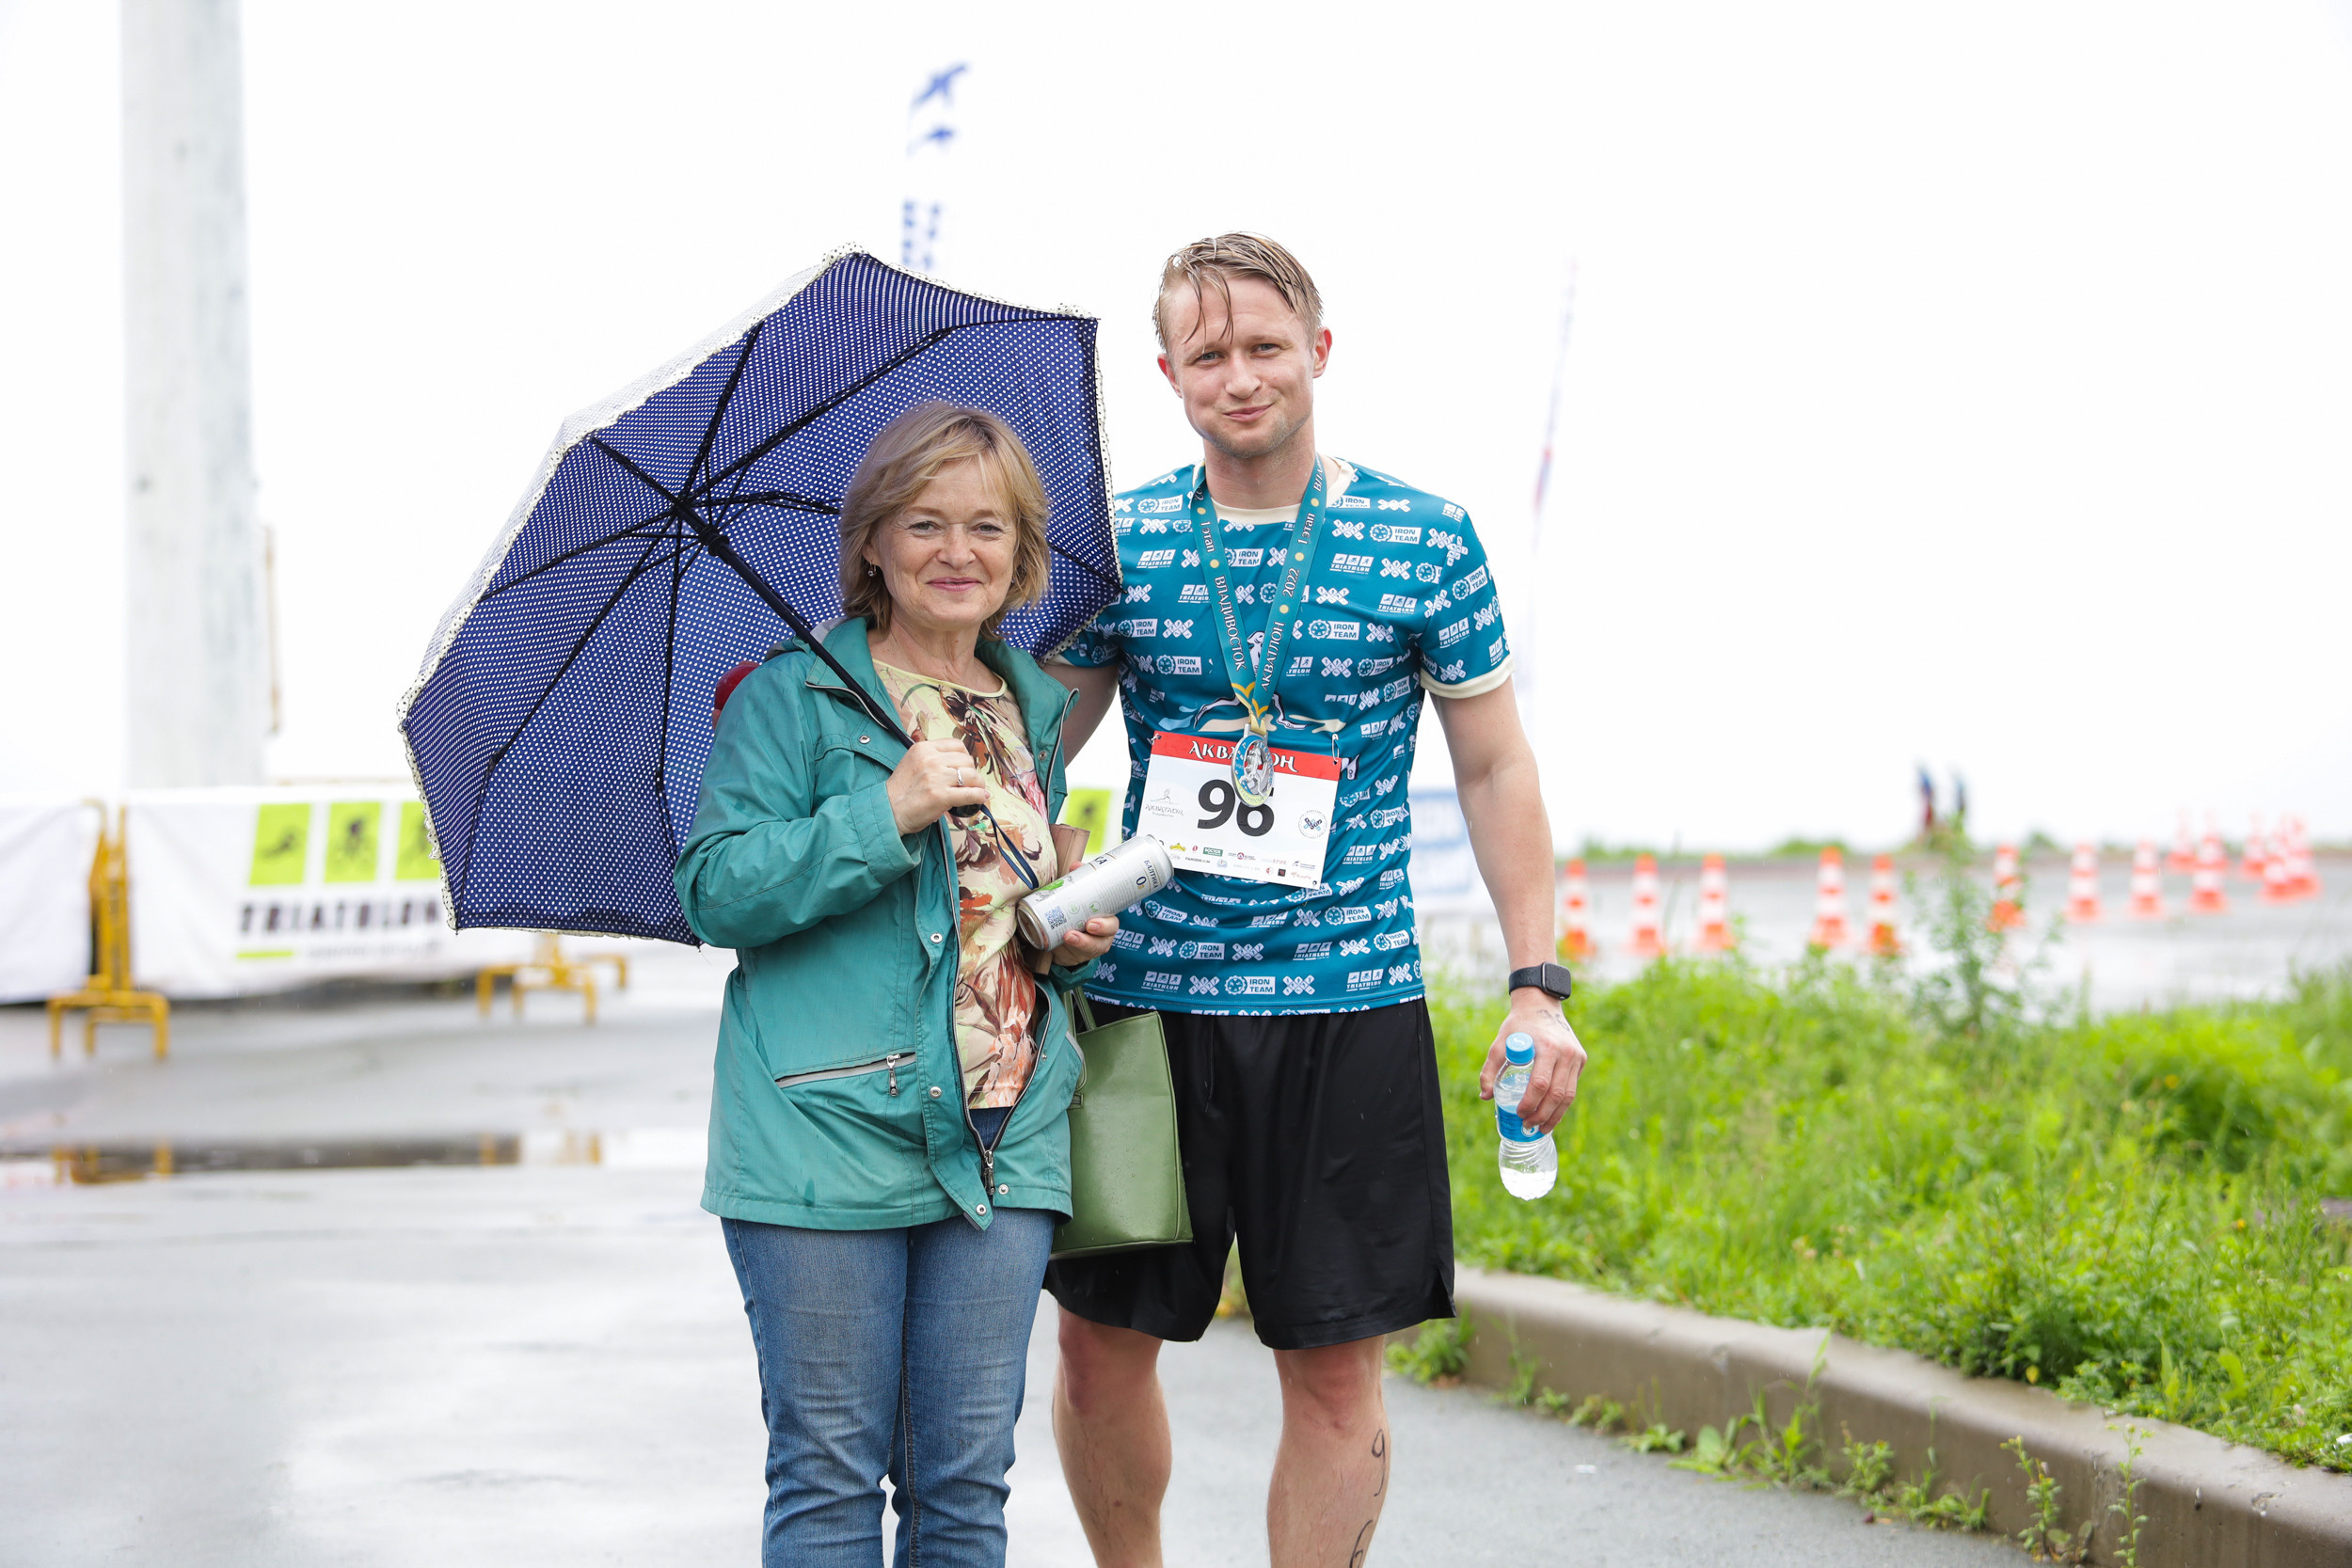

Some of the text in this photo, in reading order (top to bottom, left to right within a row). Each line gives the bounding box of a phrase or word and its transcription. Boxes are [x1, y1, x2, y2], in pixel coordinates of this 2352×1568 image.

[1301, 513, 1316, 538] этап
[1201, 528, 1216, 553] этап
[1214, 575, 1248, 672] ВЛАДИВОСТОК
[1261, 567, 1300, 691] АКВАТЛОН 2022
[1188, 740, 1299, 772] АКВОН
[1197, 779, 1275, 836] 96
[1144, 860, 1159, 889] БАЛТИКА
[1165, 909, 1183, 917] IRON
[1113, 939, 1141, 949] RIATHLON
[1142, 981, 1180, 990] TRIATHLON
[1347, 980, 1382, 989] TRIATHLON
